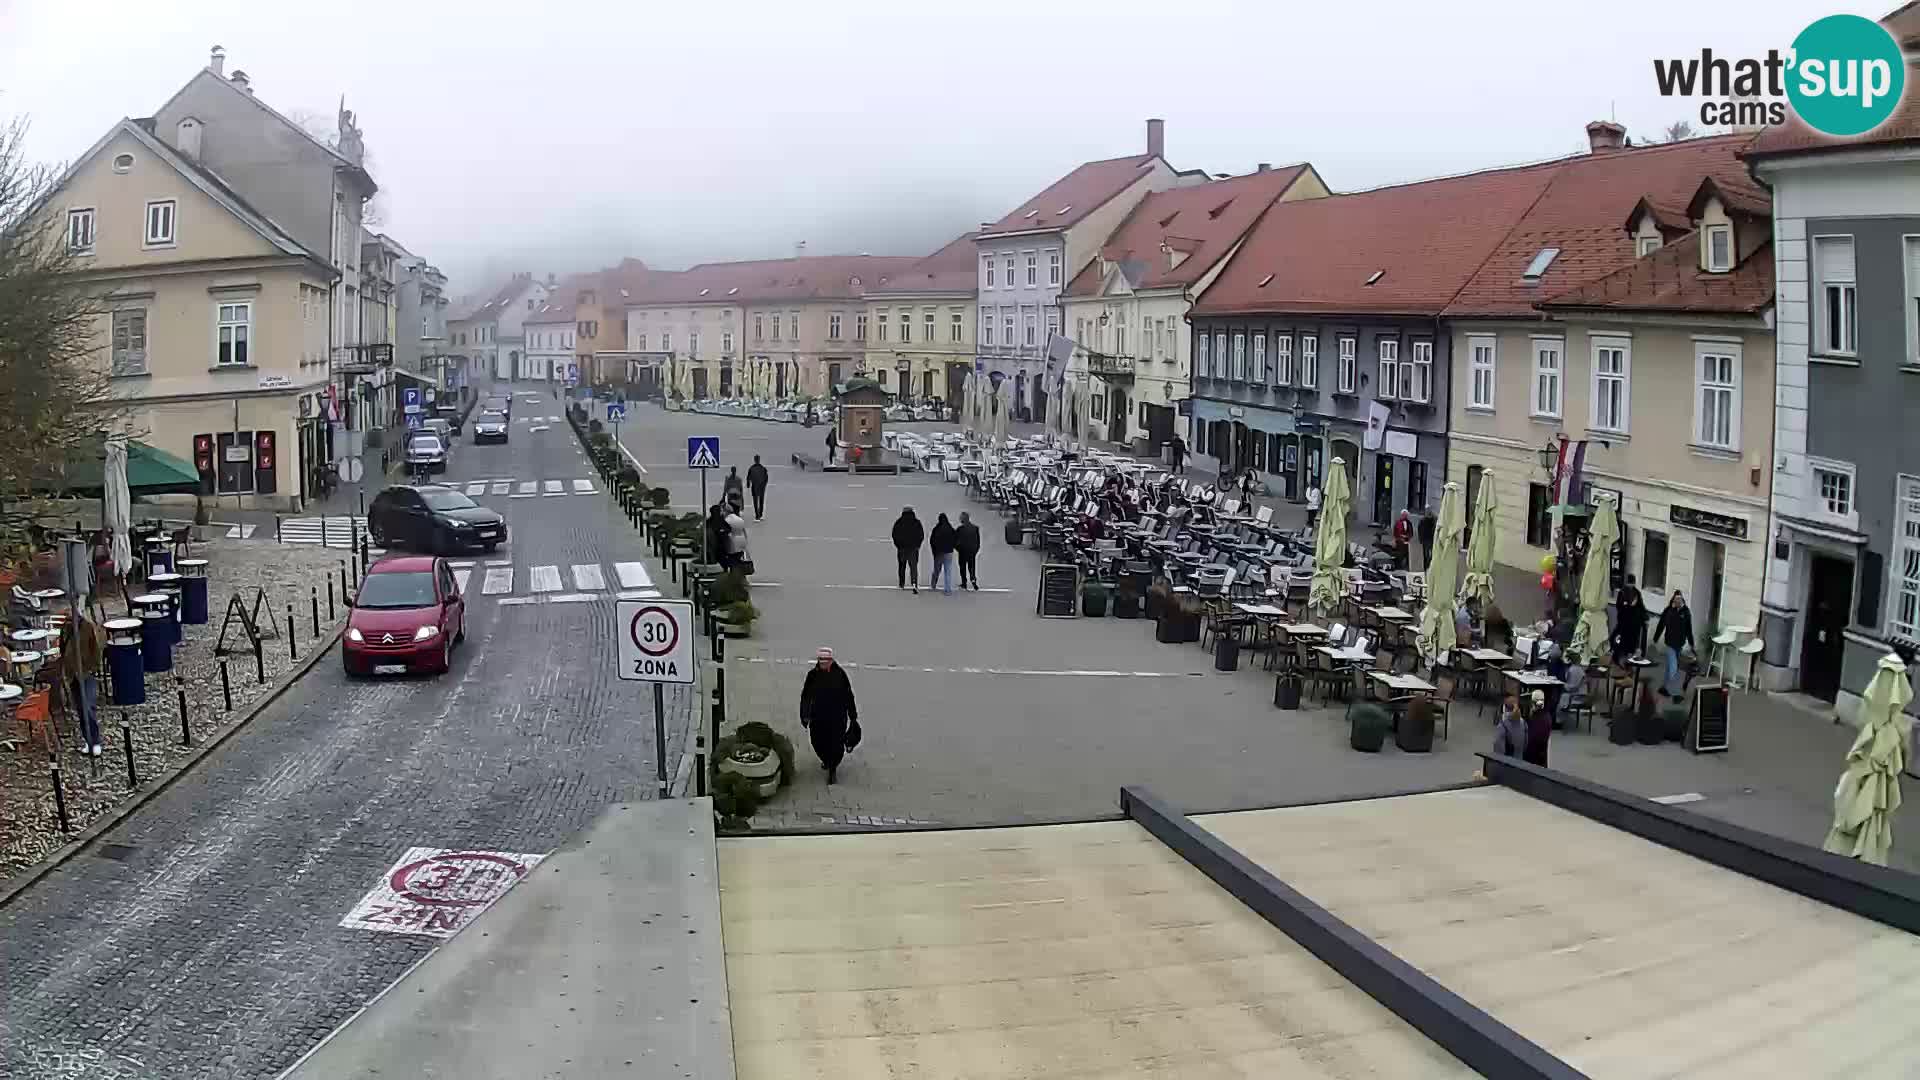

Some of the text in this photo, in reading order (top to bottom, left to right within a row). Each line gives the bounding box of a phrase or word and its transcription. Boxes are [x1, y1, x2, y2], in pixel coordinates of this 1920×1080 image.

[408, 392, 416, 403] P
[643, 622, 667, 643] 30
[633, 659, 678, 677] ZONA
